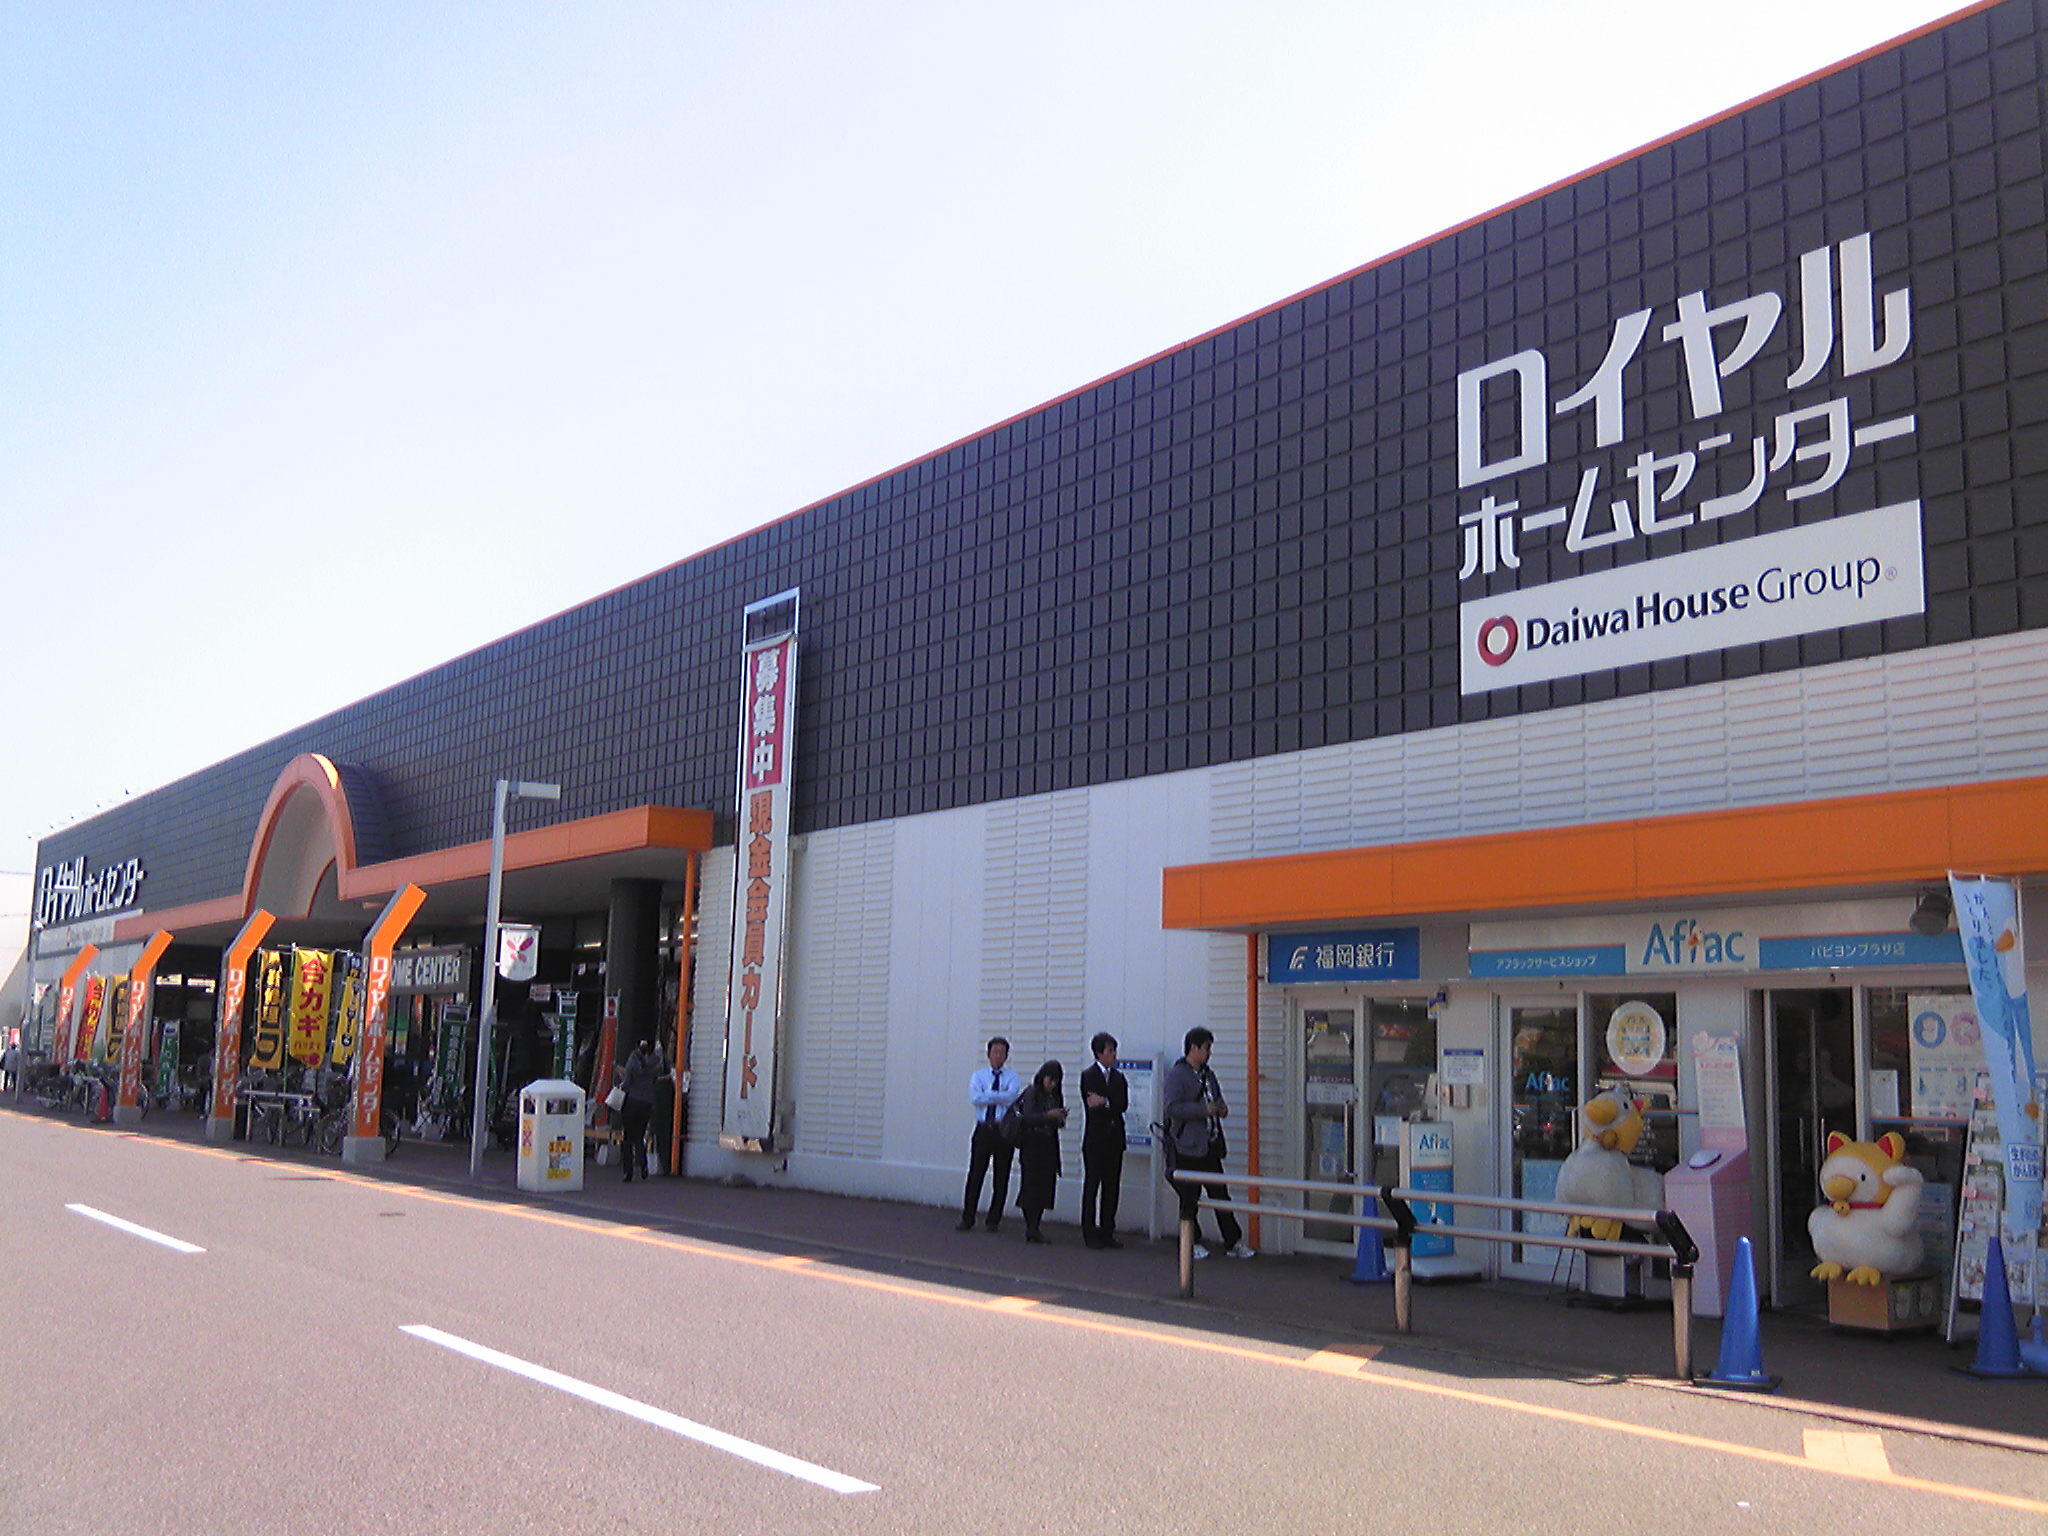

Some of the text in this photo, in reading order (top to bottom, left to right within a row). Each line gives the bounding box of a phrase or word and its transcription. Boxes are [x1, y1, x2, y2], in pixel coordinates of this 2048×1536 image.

[1457, 232, 1911, 489] ロイヤル
[1458, 396, 1915, 581] ホームセンター
[1526, 557, 1881, 651] Daiwa House Group
[752, 647, 780, 783] 募集中
[415, 955, 460, 987] CENTER
[1315, 941, 1395, 970] 福岡銀行
[1642, 919, 1746, 966] Aflac
[296, 958, 329, 1038] 合カギ
[363, 957, 389, 1124] ロイヤルホームセンター
[1525, 1071, 1569, 1092] Aflac
[1419, 1133, 1451, 1151] Aflac
